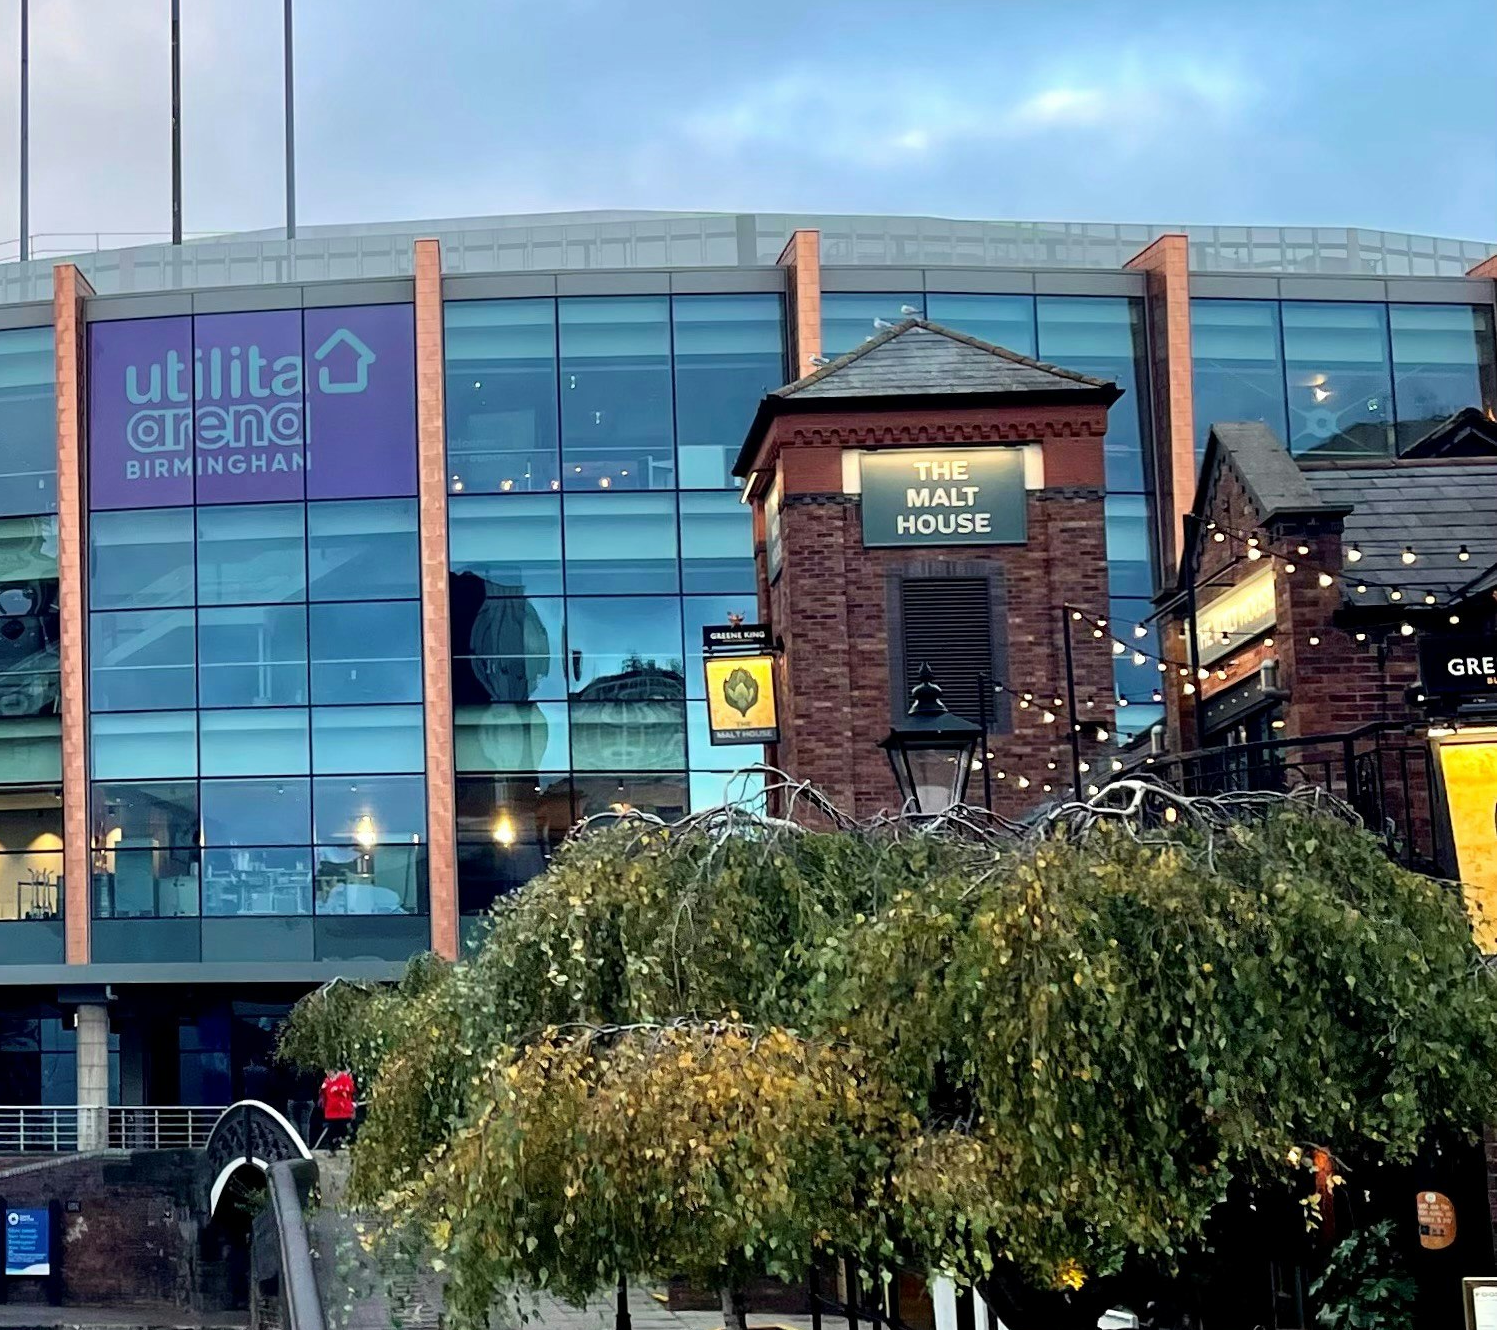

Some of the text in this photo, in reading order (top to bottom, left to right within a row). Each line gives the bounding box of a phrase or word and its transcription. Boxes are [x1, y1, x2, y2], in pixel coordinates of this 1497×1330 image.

[126, 345, 310, 404] utilita
[126, 402, 311, 453] arena
[126, 451, 311, 480] BIRMINGHAM
[913, 460, 969, 481] THE
[906, 486, 979, 507] MALT
[897, 513, 991, 534] HOUSE
[710, 630, 765, 640] GREENE KING
[716, 729, 773, 739] MALT HOUSE
